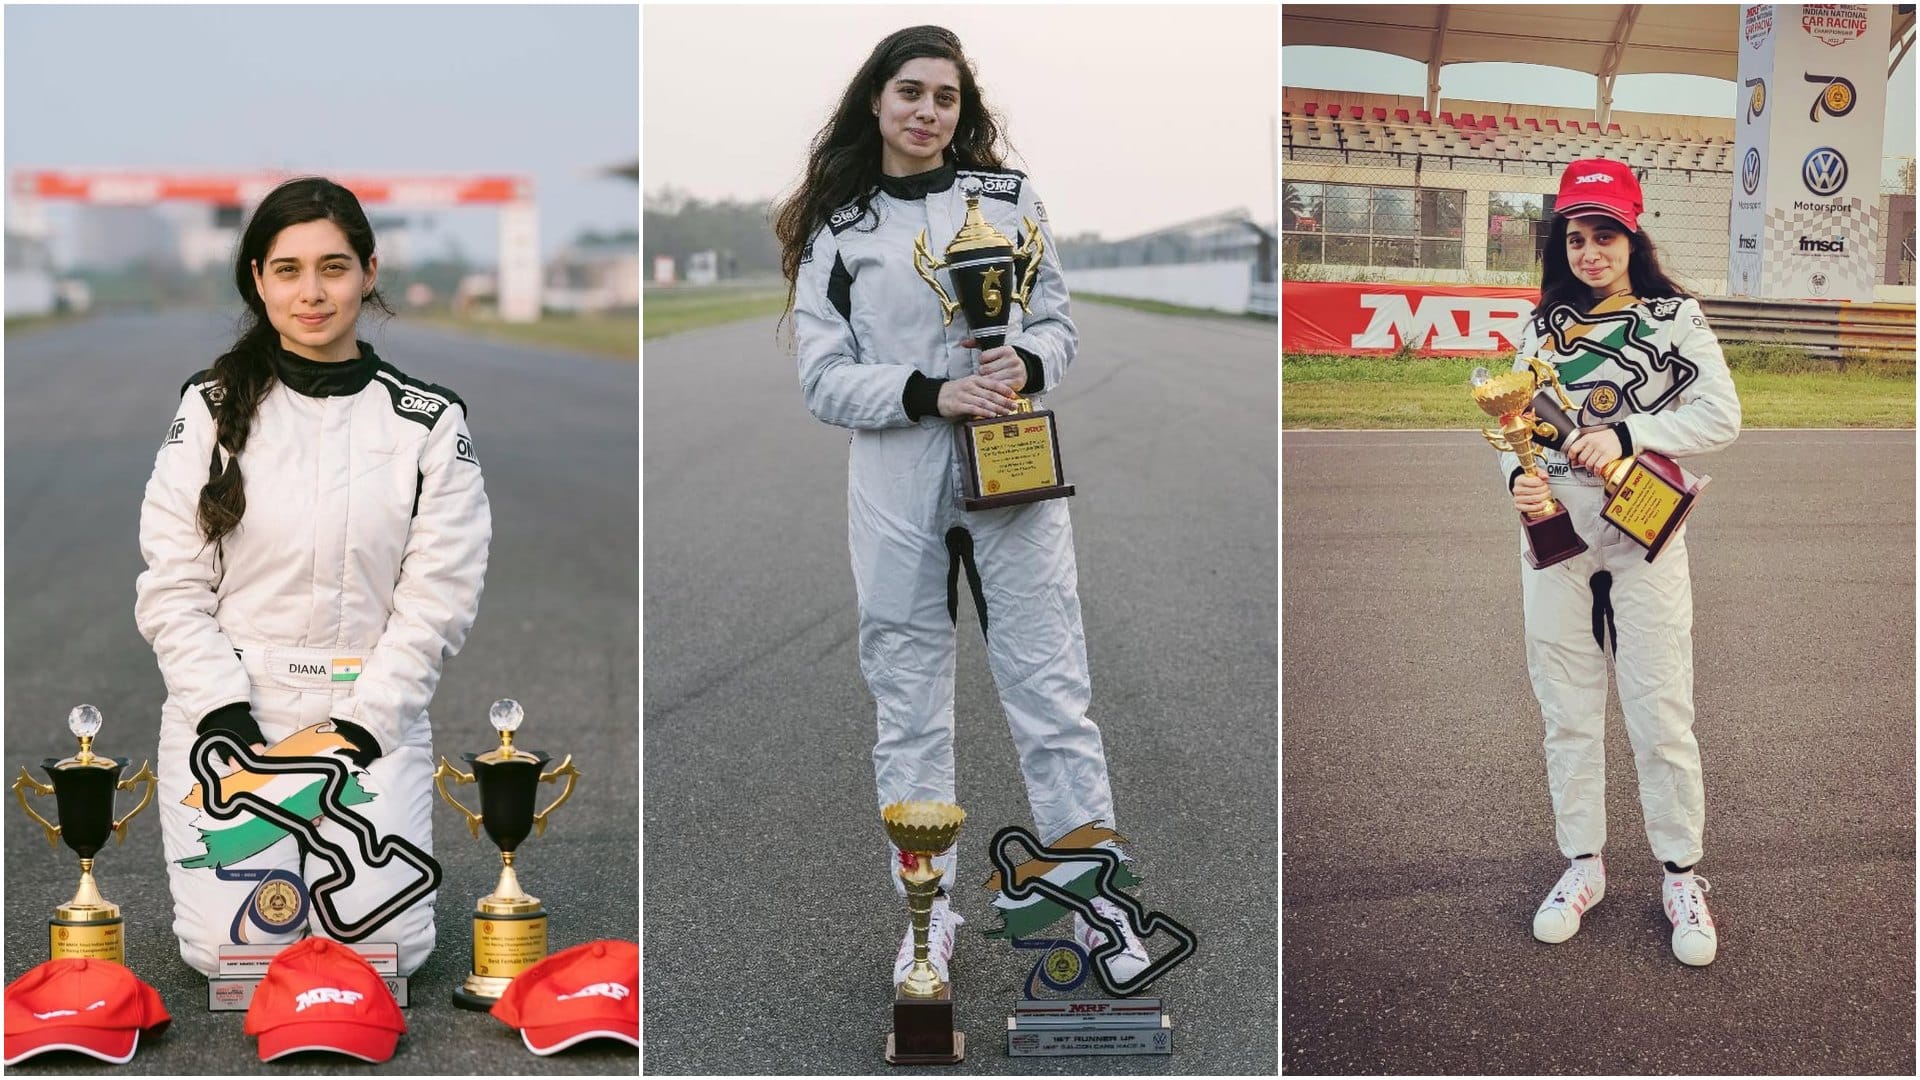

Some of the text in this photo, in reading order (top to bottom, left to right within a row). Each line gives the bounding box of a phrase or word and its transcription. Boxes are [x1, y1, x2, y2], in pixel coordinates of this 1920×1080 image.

[1803, 8, 1867, 19] INDIAN NATIONAL
[1802, 16, 1867, 29] CAR RACING
[983, 178, 1017, 192] OMP
[1793, 200, 1852, 213] Motorsport
[1799, 234, 1846, 252] fmsci
[1351, 294, 1538, 350] MR
[401, 395, 440, 414] OMP
[1547, 465, 1568, 475] OMP
[289, 663, 327, 675] DIANA
[295, 987, 364, 1013] MRF
[1068, 1004, 1110, 1013] MRF
